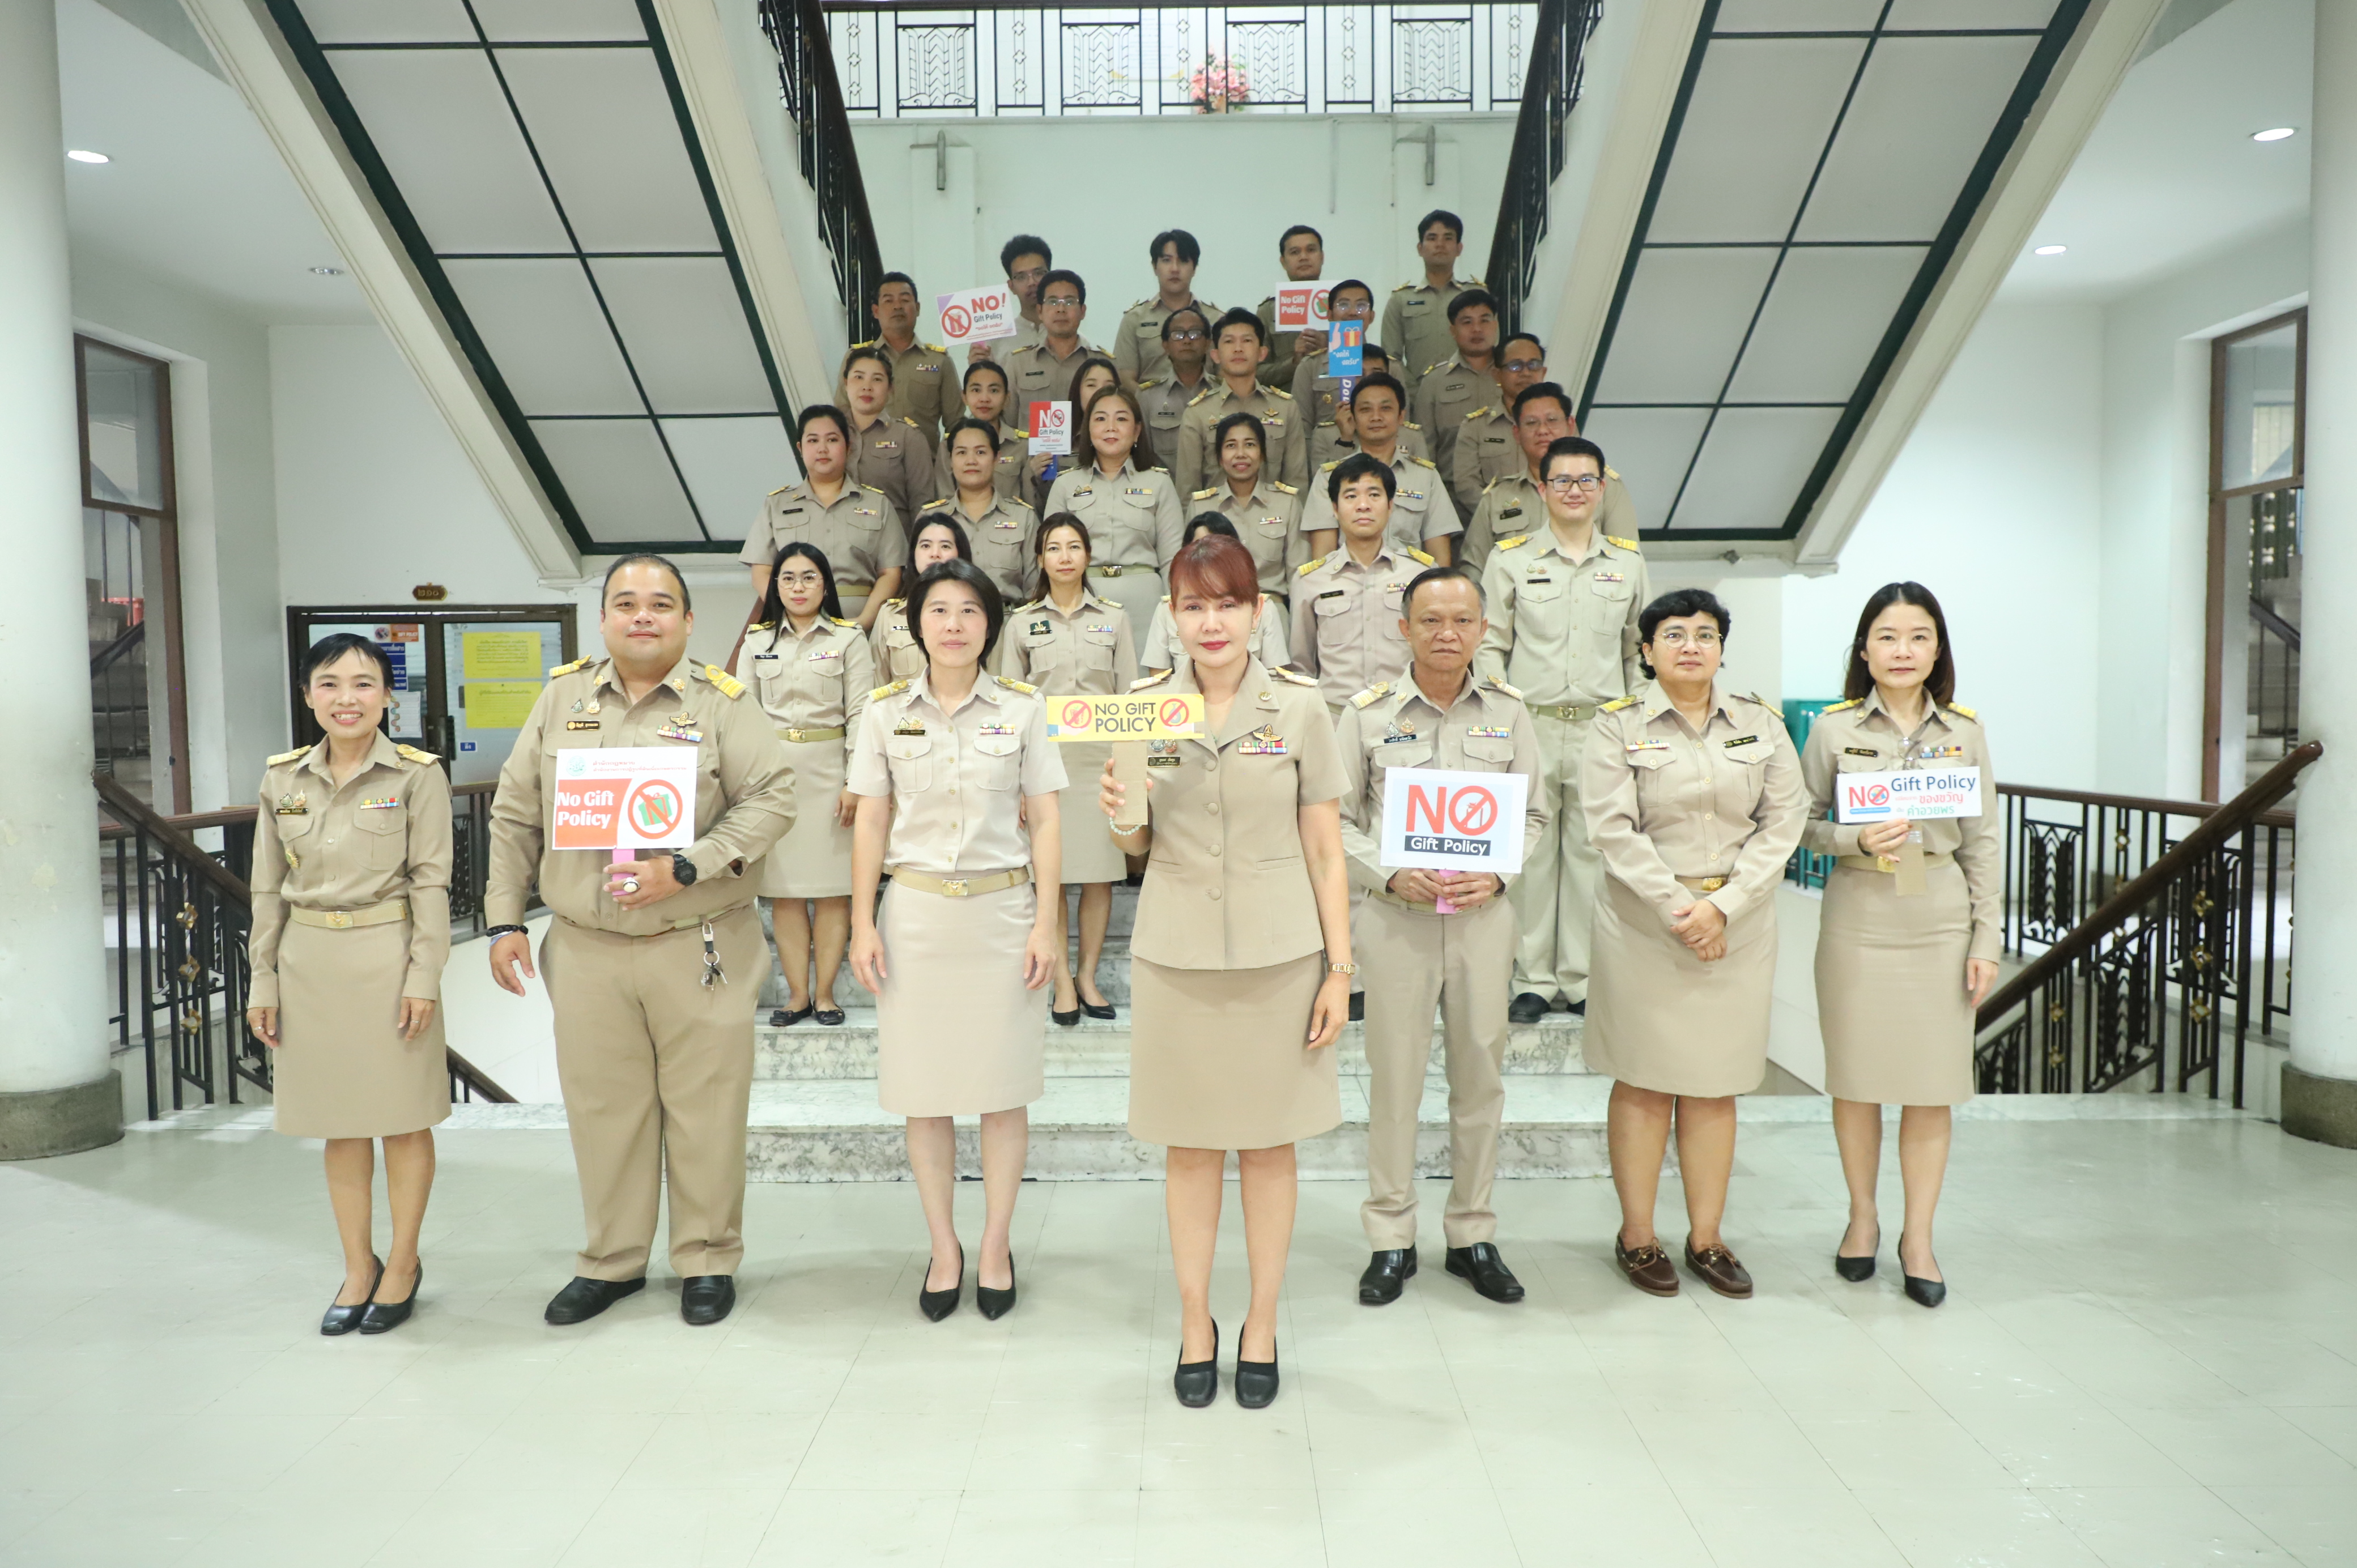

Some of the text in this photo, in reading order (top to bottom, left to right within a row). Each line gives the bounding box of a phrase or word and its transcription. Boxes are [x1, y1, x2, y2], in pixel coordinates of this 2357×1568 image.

[1292, 295, 1305, 304] Gift
[1282, 305, 1305, 315] Policy
[1095, 702, 1156, 716] NO GIFT
[1095, 717, 1156, 733] POLICY
[1891, 774, 1976, 791] Gift Policy
[557, 790, 615, 806] No Gift
[1919, 792, 1964, 804] ของขวัญ
[1907, 804, 1955, 816] คำอวยพร
[557, 809, 611, 829] Policy
[1411, 837, 1487, 856] Gift Policy
